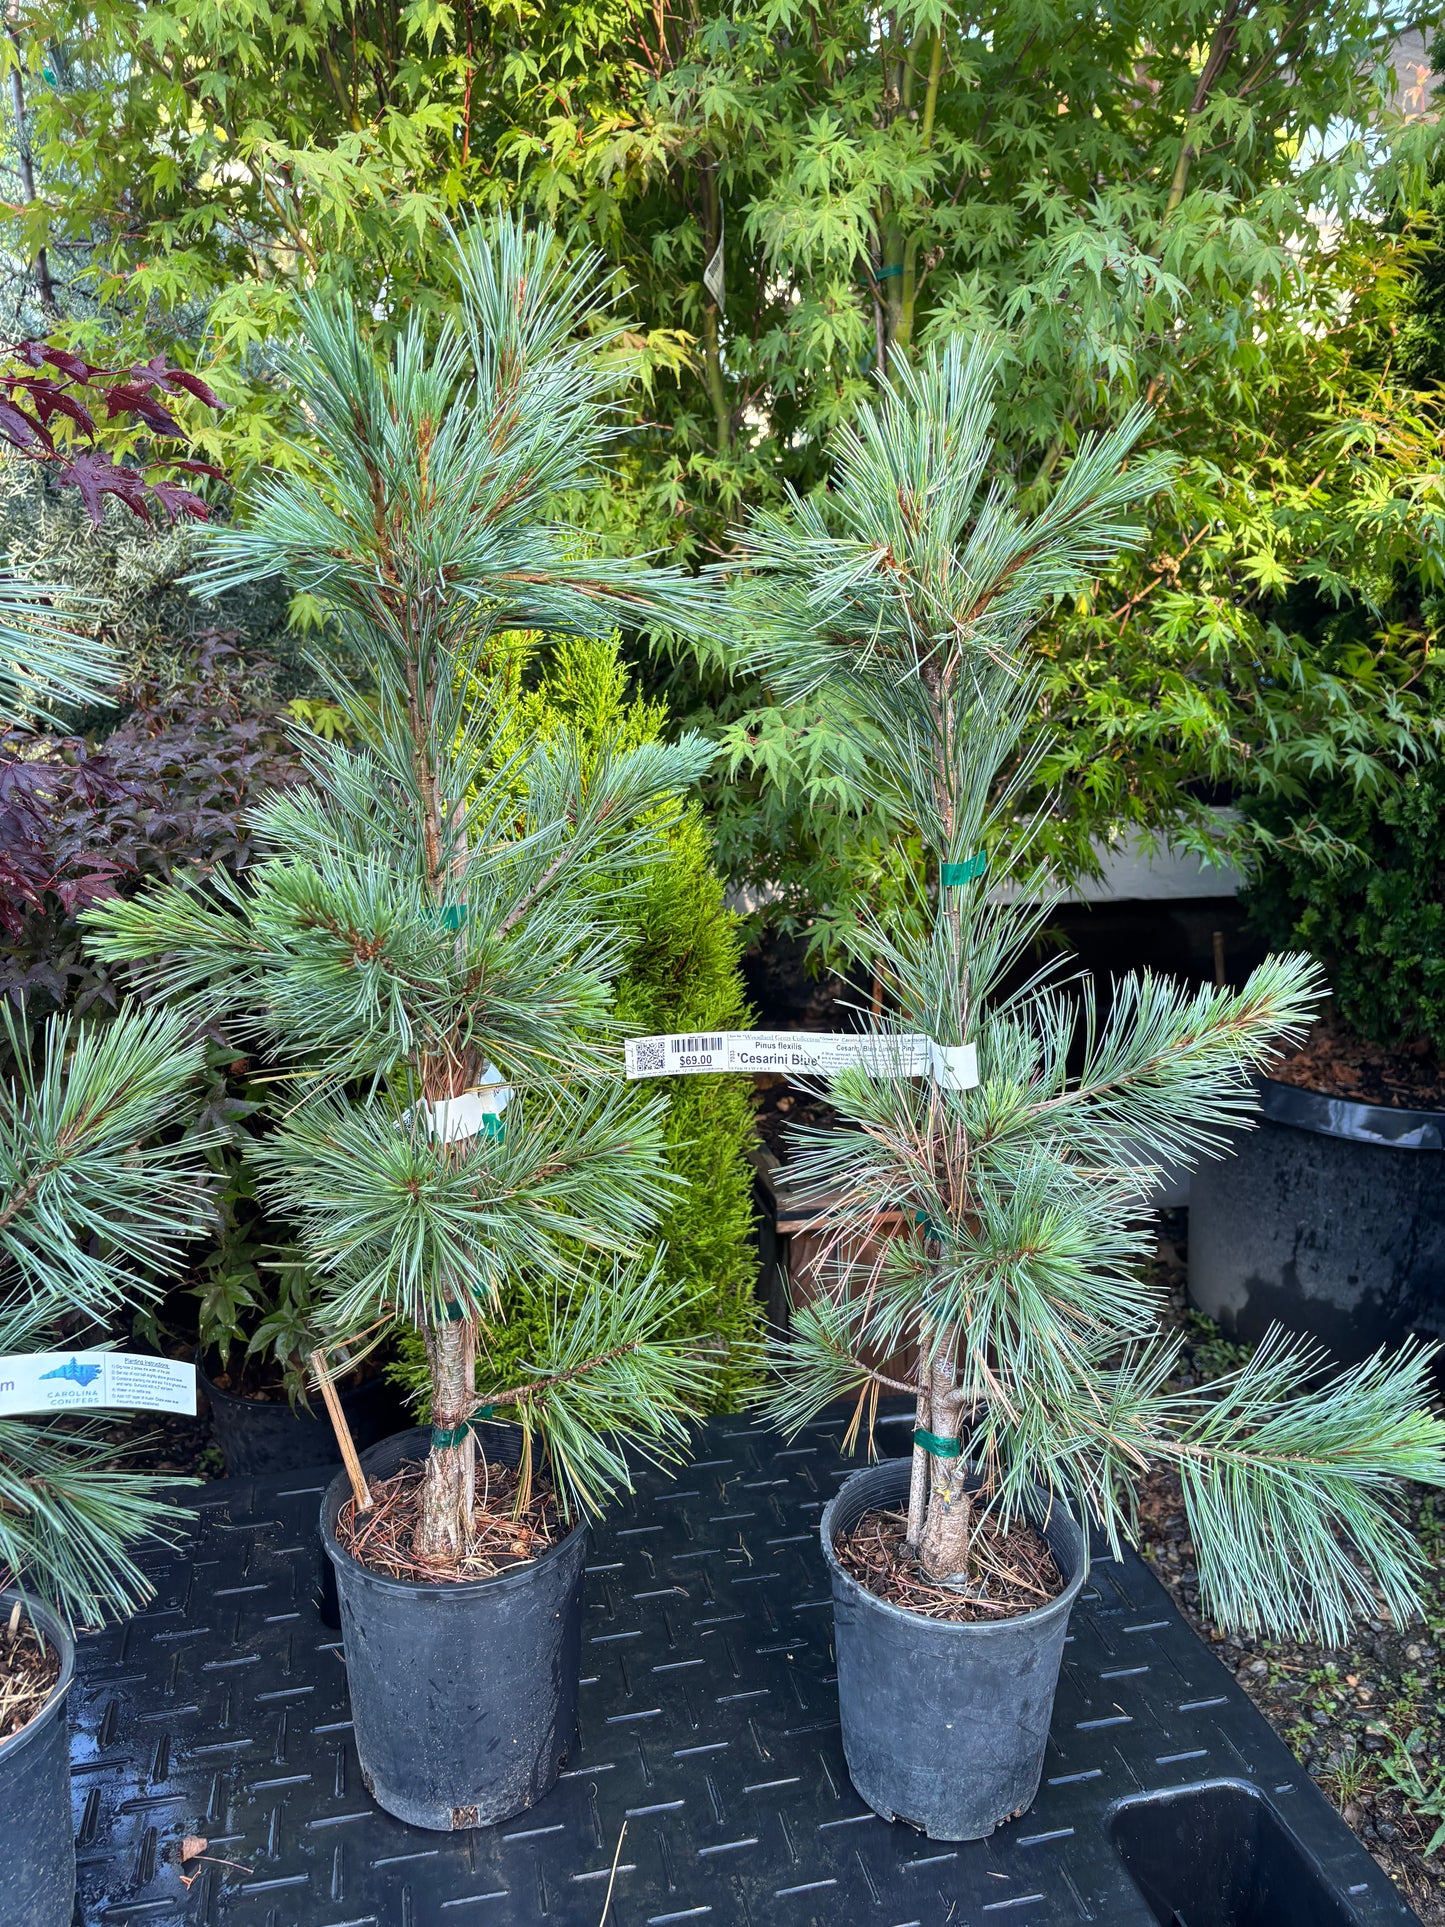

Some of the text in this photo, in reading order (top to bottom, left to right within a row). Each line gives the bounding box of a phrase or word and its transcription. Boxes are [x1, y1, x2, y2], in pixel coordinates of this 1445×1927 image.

[755, 1041, 802, 1050] Pinus flexilis
[679, 1054, 713, 1066] $69.00
[47, 1390, 98, 1399] CAROLINA
[50, 1397, 100, 1406] CONIFERS
